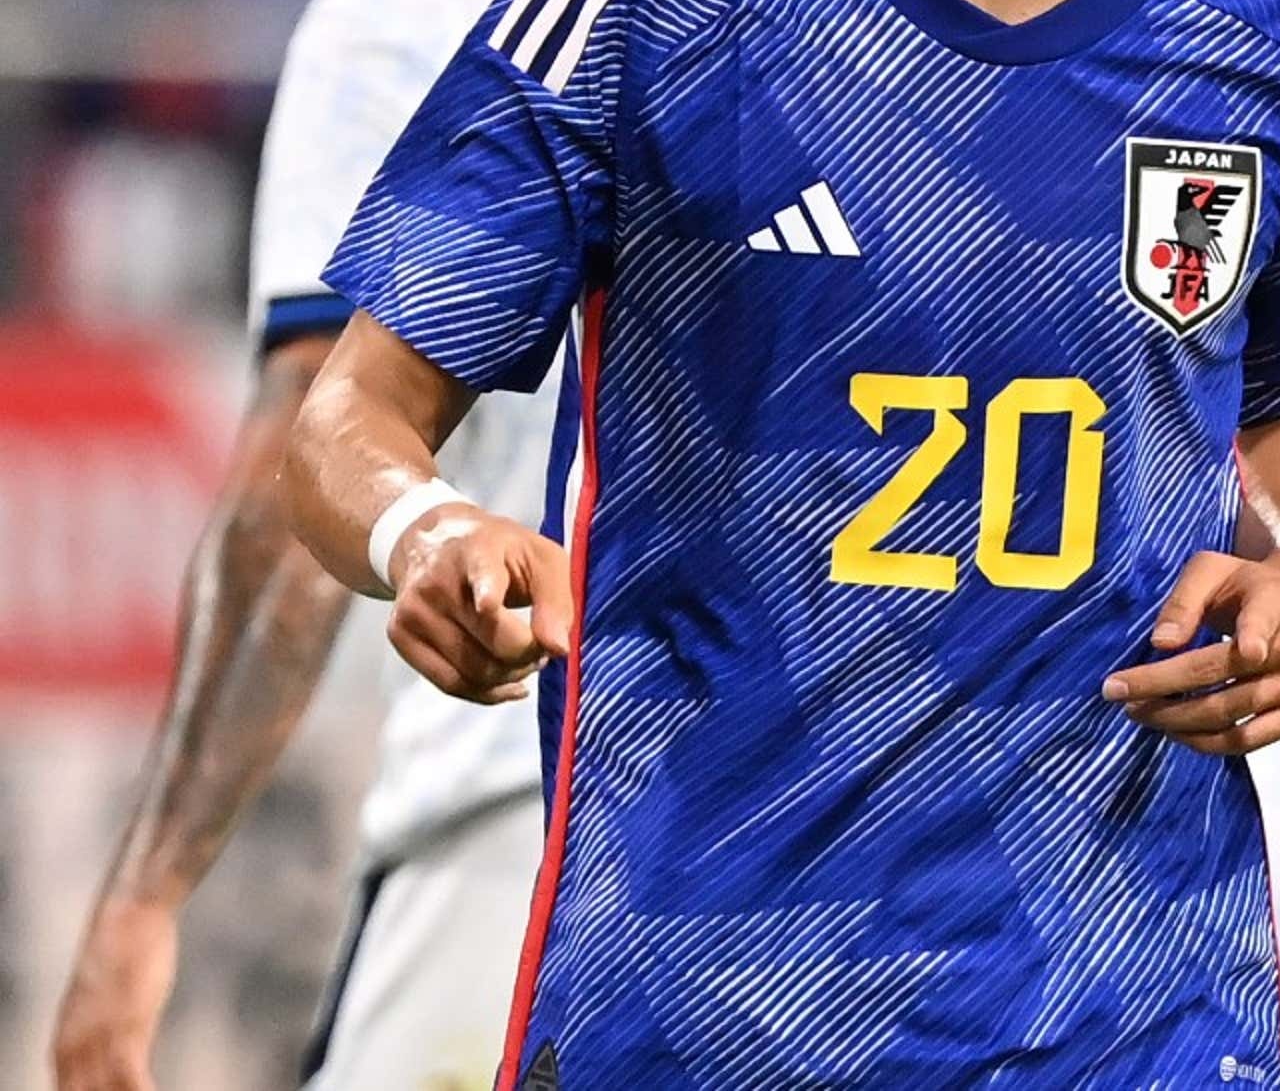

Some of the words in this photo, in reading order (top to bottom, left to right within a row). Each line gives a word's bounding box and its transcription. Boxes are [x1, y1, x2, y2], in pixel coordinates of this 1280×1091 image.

[1164, 149, 1233, 169] JAPAN
[1160, 273, 1210, 302] JFA
[830, 372, 1107, 593] 20
